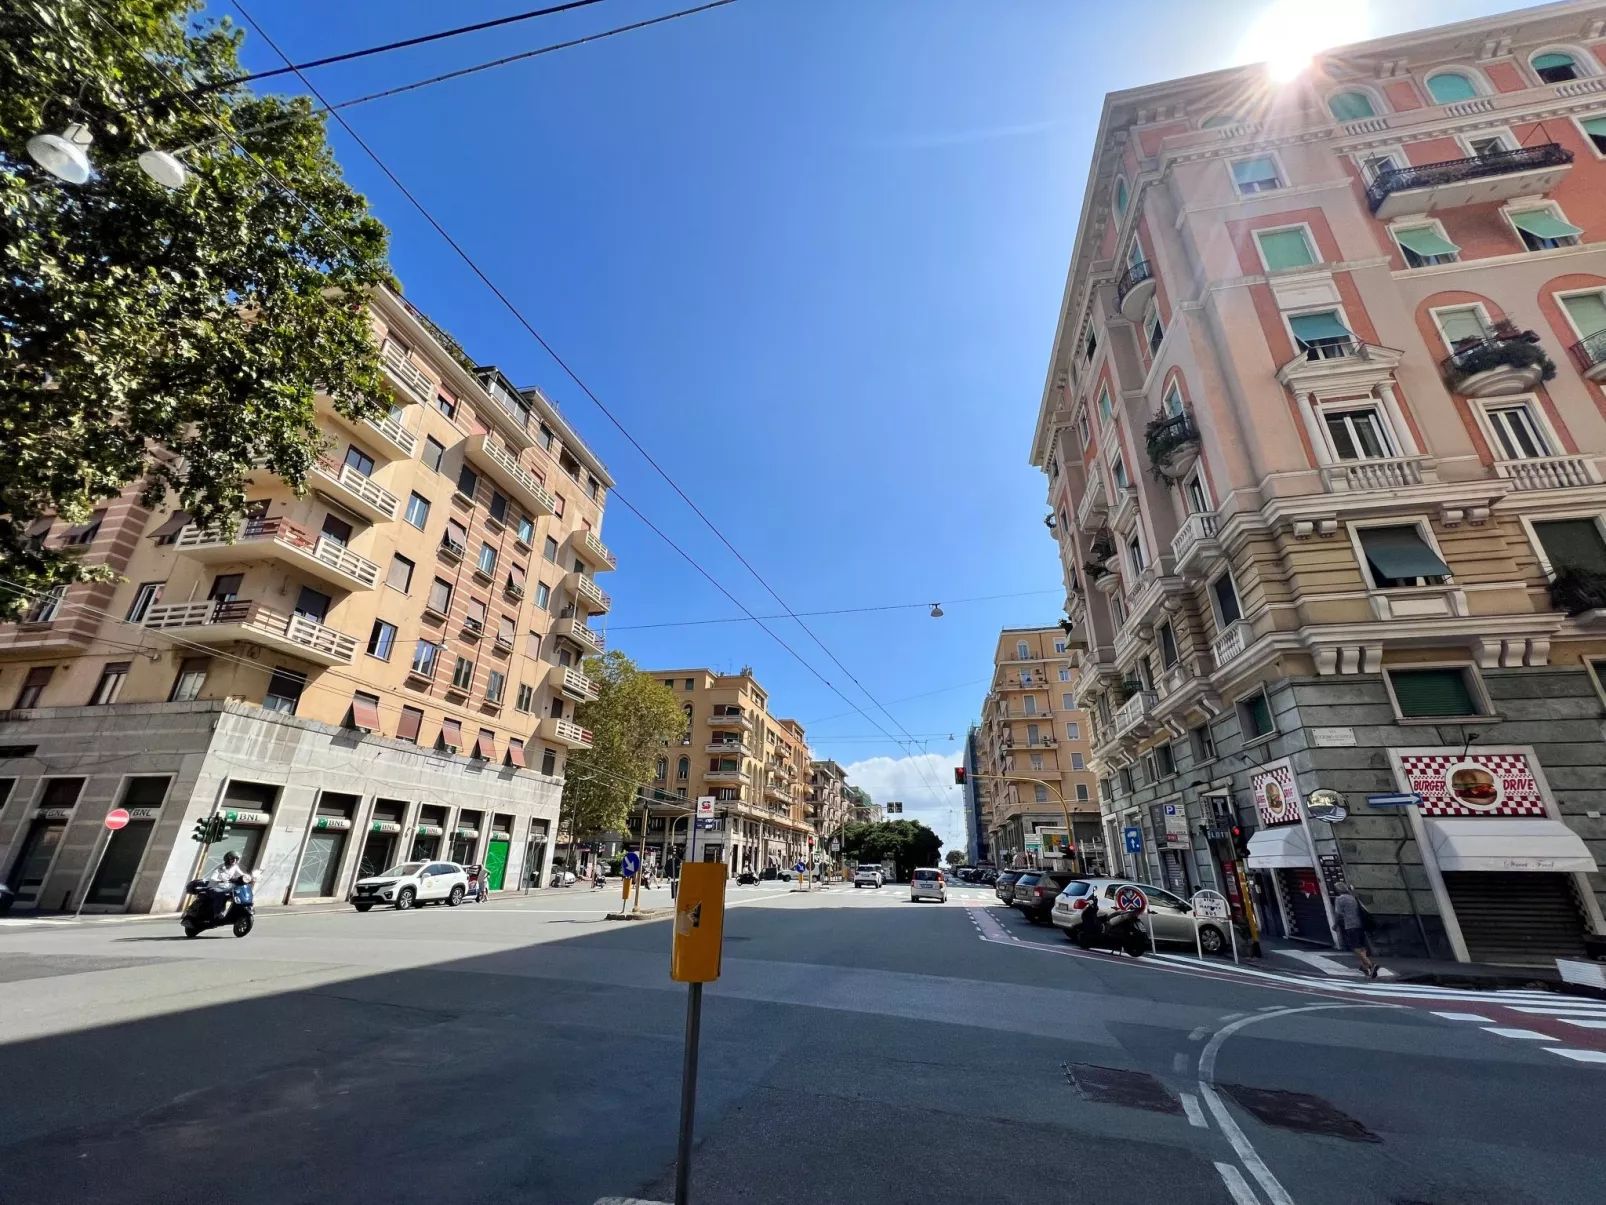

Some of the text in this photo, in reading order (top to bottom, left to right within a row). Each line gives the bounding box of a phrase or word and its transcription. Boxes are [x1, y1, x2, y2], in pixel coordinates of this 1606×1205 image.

[1414, 779, 1534, 792] BURGER DRIVE
[48, 809, 65, 817] BNL
[133, 808, 151, 816] BNL
[1166, 806, 1174, 814] P
[239, 813, 259, 821] BNL
[328, 819, 345, 827] BNL
